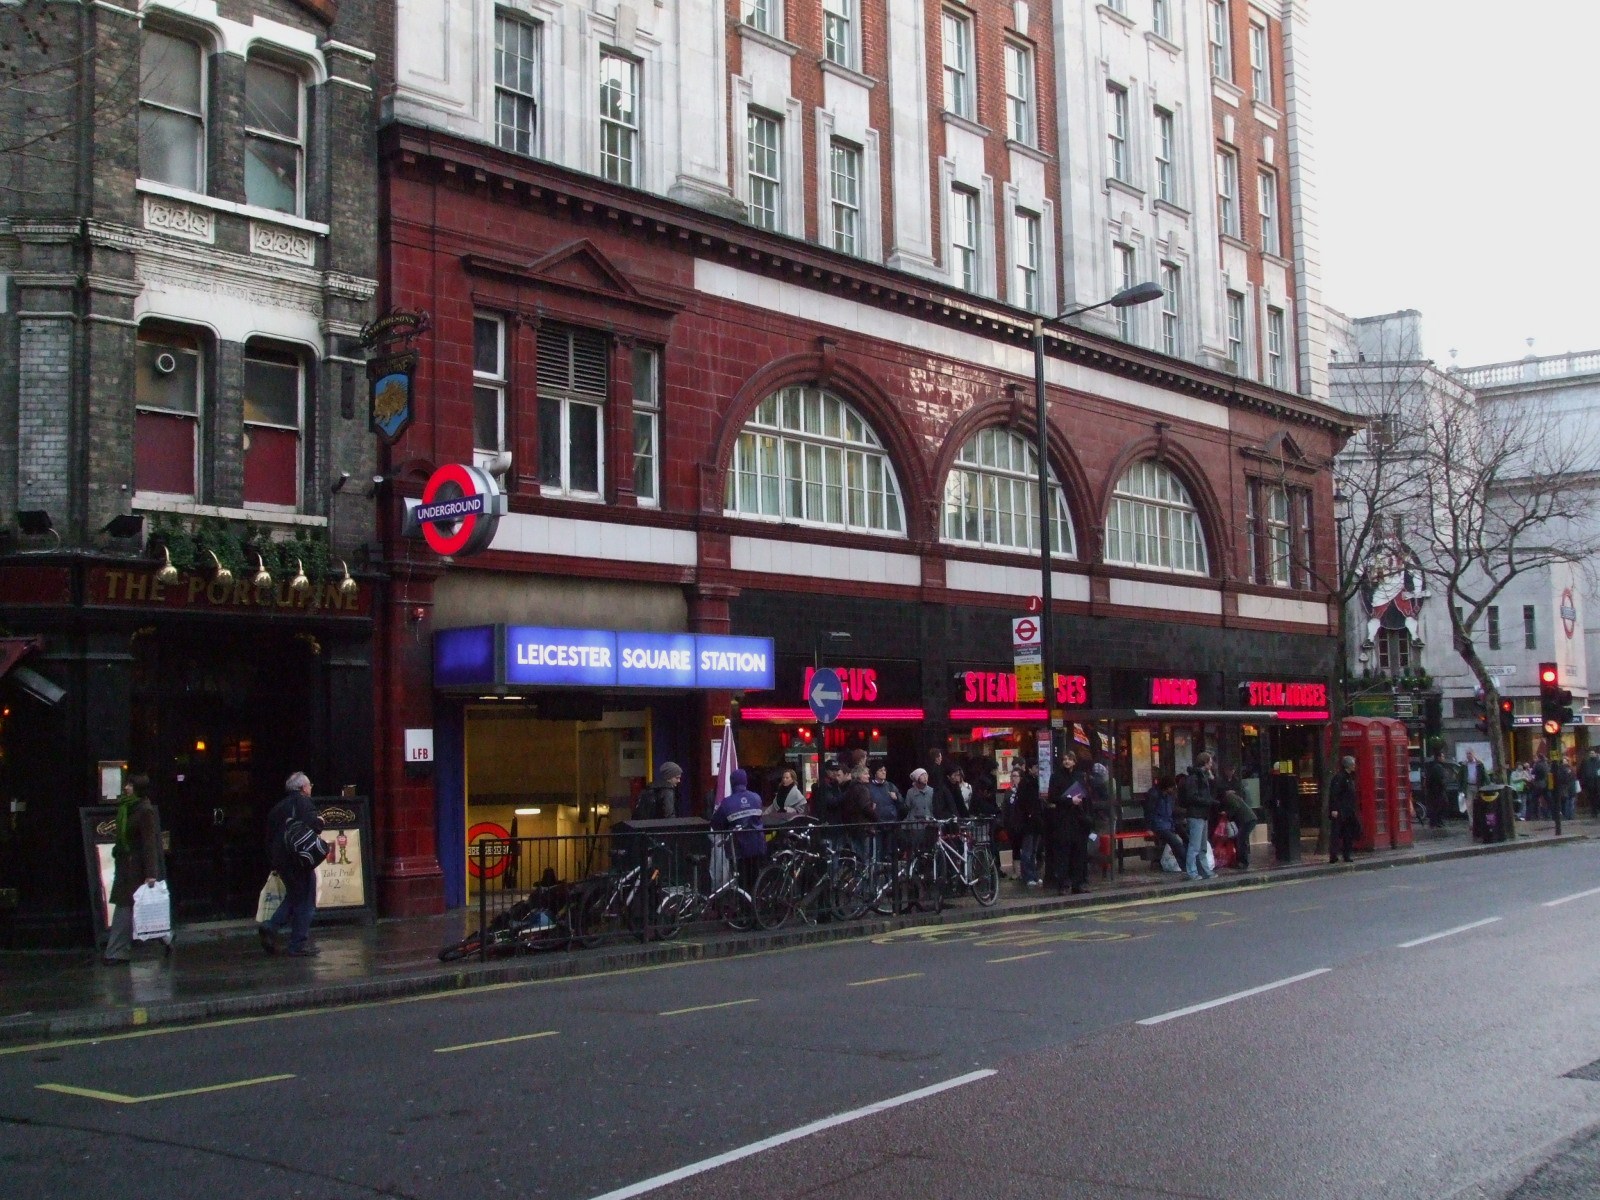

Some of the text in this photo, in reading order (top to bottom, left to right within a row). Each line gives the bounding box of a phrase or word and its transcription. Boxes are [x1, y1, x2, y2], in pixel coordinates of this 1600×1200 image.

[417, 499, 481, 520] UNDERGROUND
[105, 571, 167, 602] THE
[1029, 599, 1036, 611] J
[517, 643, 766, 672] LEICESTER SQUARE STATION
[1152, 677, 1198, 705] ANGUS
[412, 748, 429, 760] LFB
